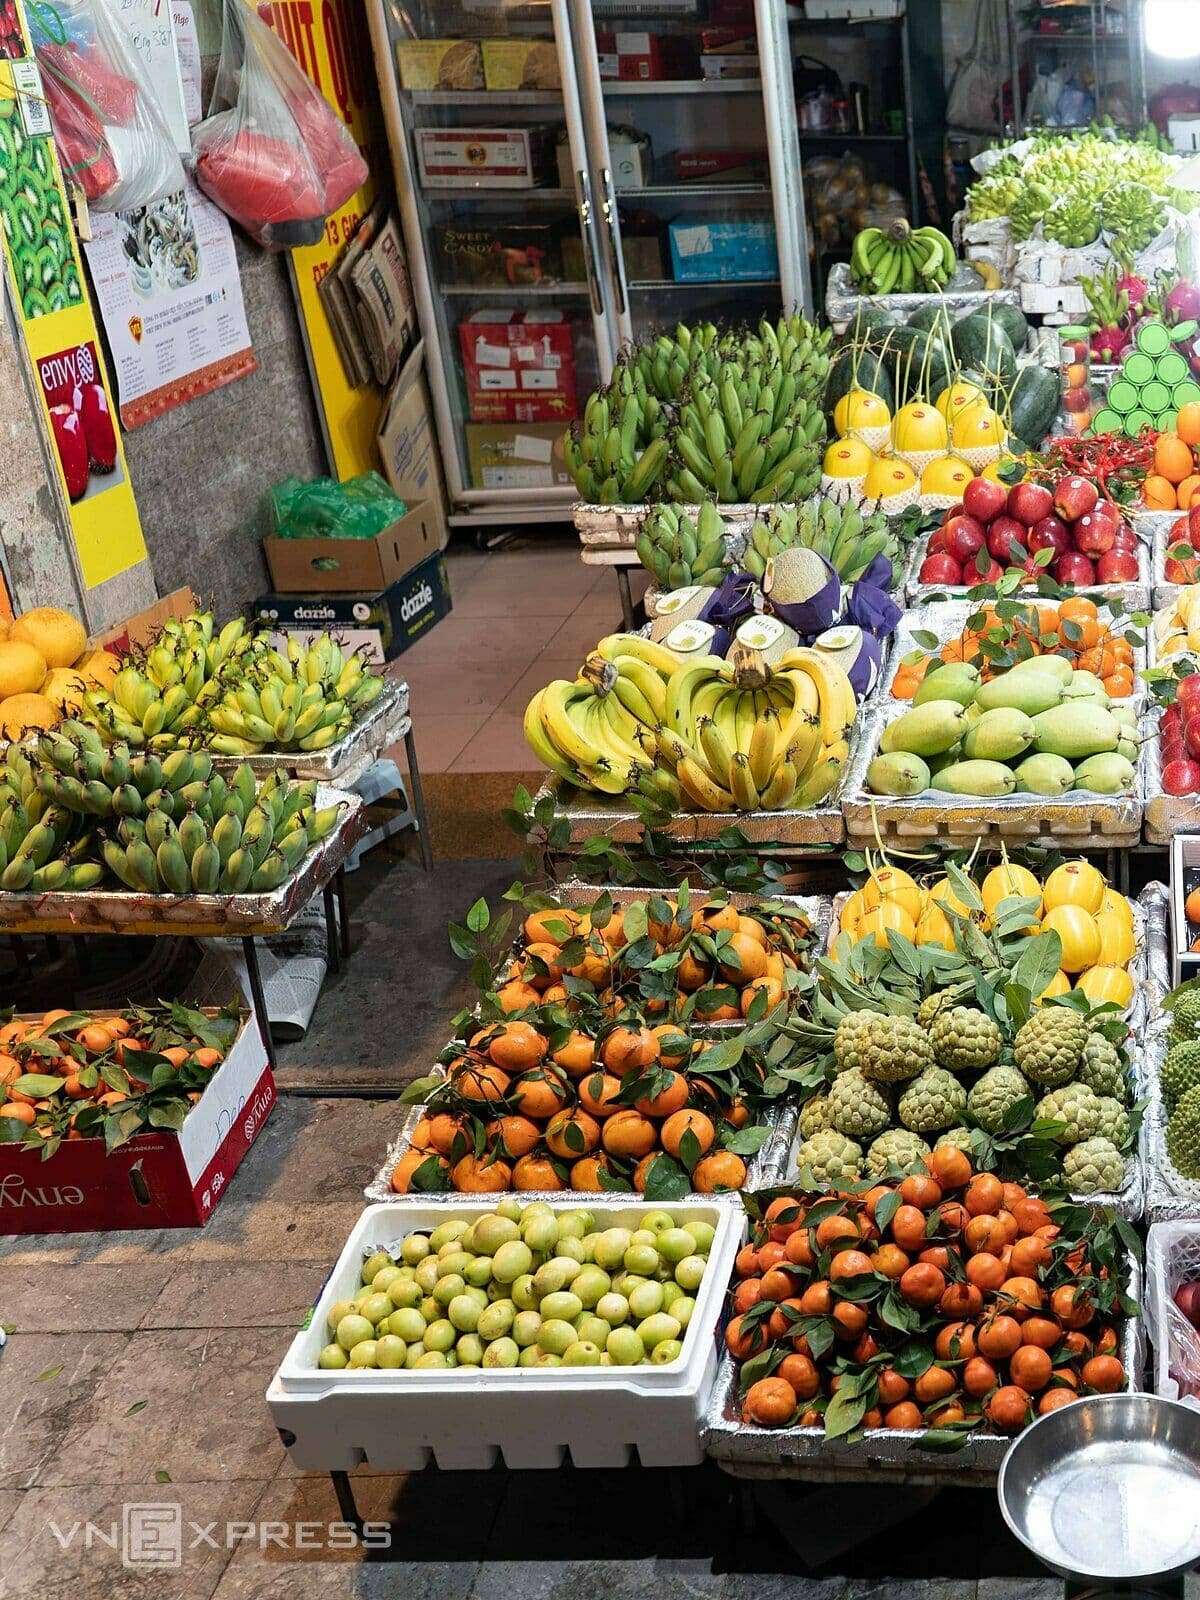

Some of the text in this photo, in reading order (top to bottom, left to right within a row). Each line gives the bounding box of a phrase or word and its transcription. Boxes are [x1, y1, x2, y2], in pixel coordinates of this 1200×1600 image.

[325, 220, 340, 247] 13
[444, 230, 490, 241] SWEET
[444, 241, 493, 253] CANDY
[41, 353, 82, 391] envy
[294, 606, 336, 619] dazzle
[401, 584, 433, 622] dazzle
[252, 1086, 272, 1124] envy
[0, 1174, 84, 1208] envy
